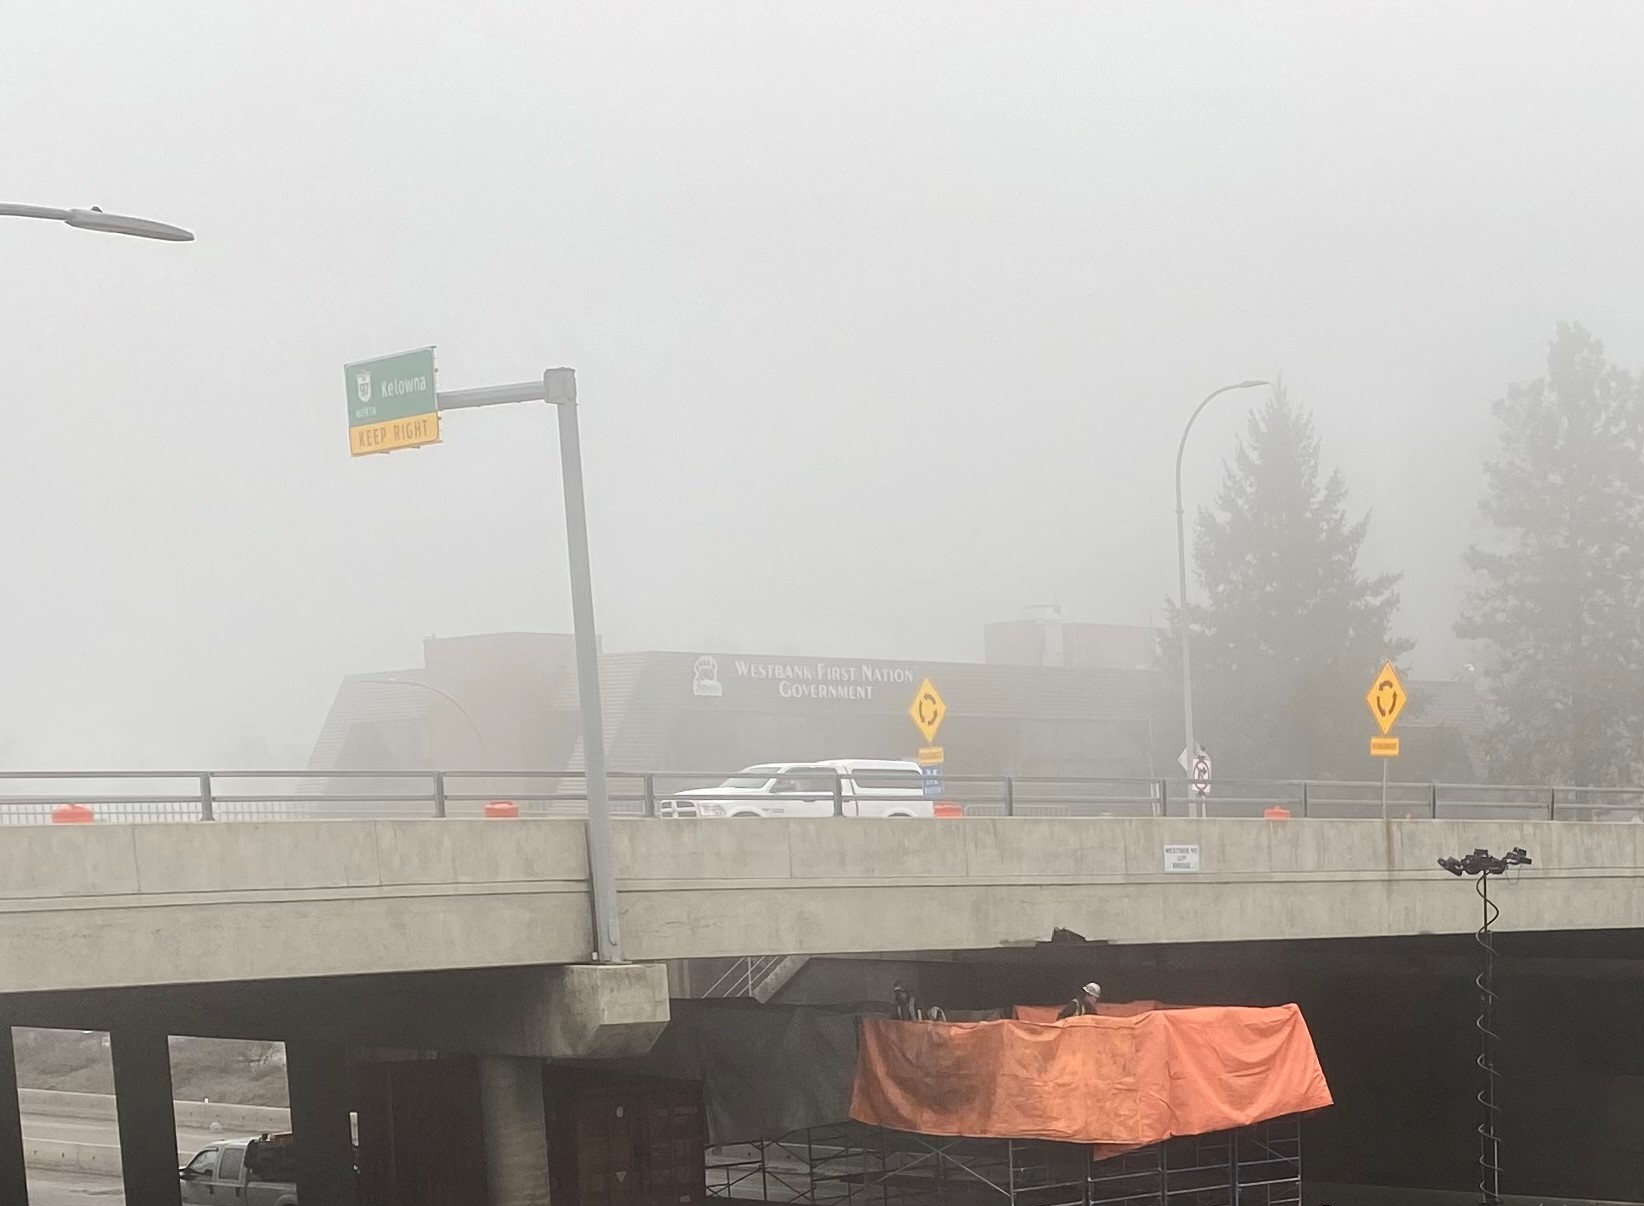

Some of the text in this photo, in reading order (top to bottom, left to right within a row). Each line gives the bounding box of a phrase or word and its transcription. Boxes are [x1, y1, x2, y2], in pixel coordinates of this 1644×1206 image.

[381, 376, 427, 398] Kelowna
[359, 420, 428, 447] KEEP RIGHT
[735, 660, 914, 683] WESTBANK FIRST NATION
[778, 681, 873, 700] GOVERNMENT
